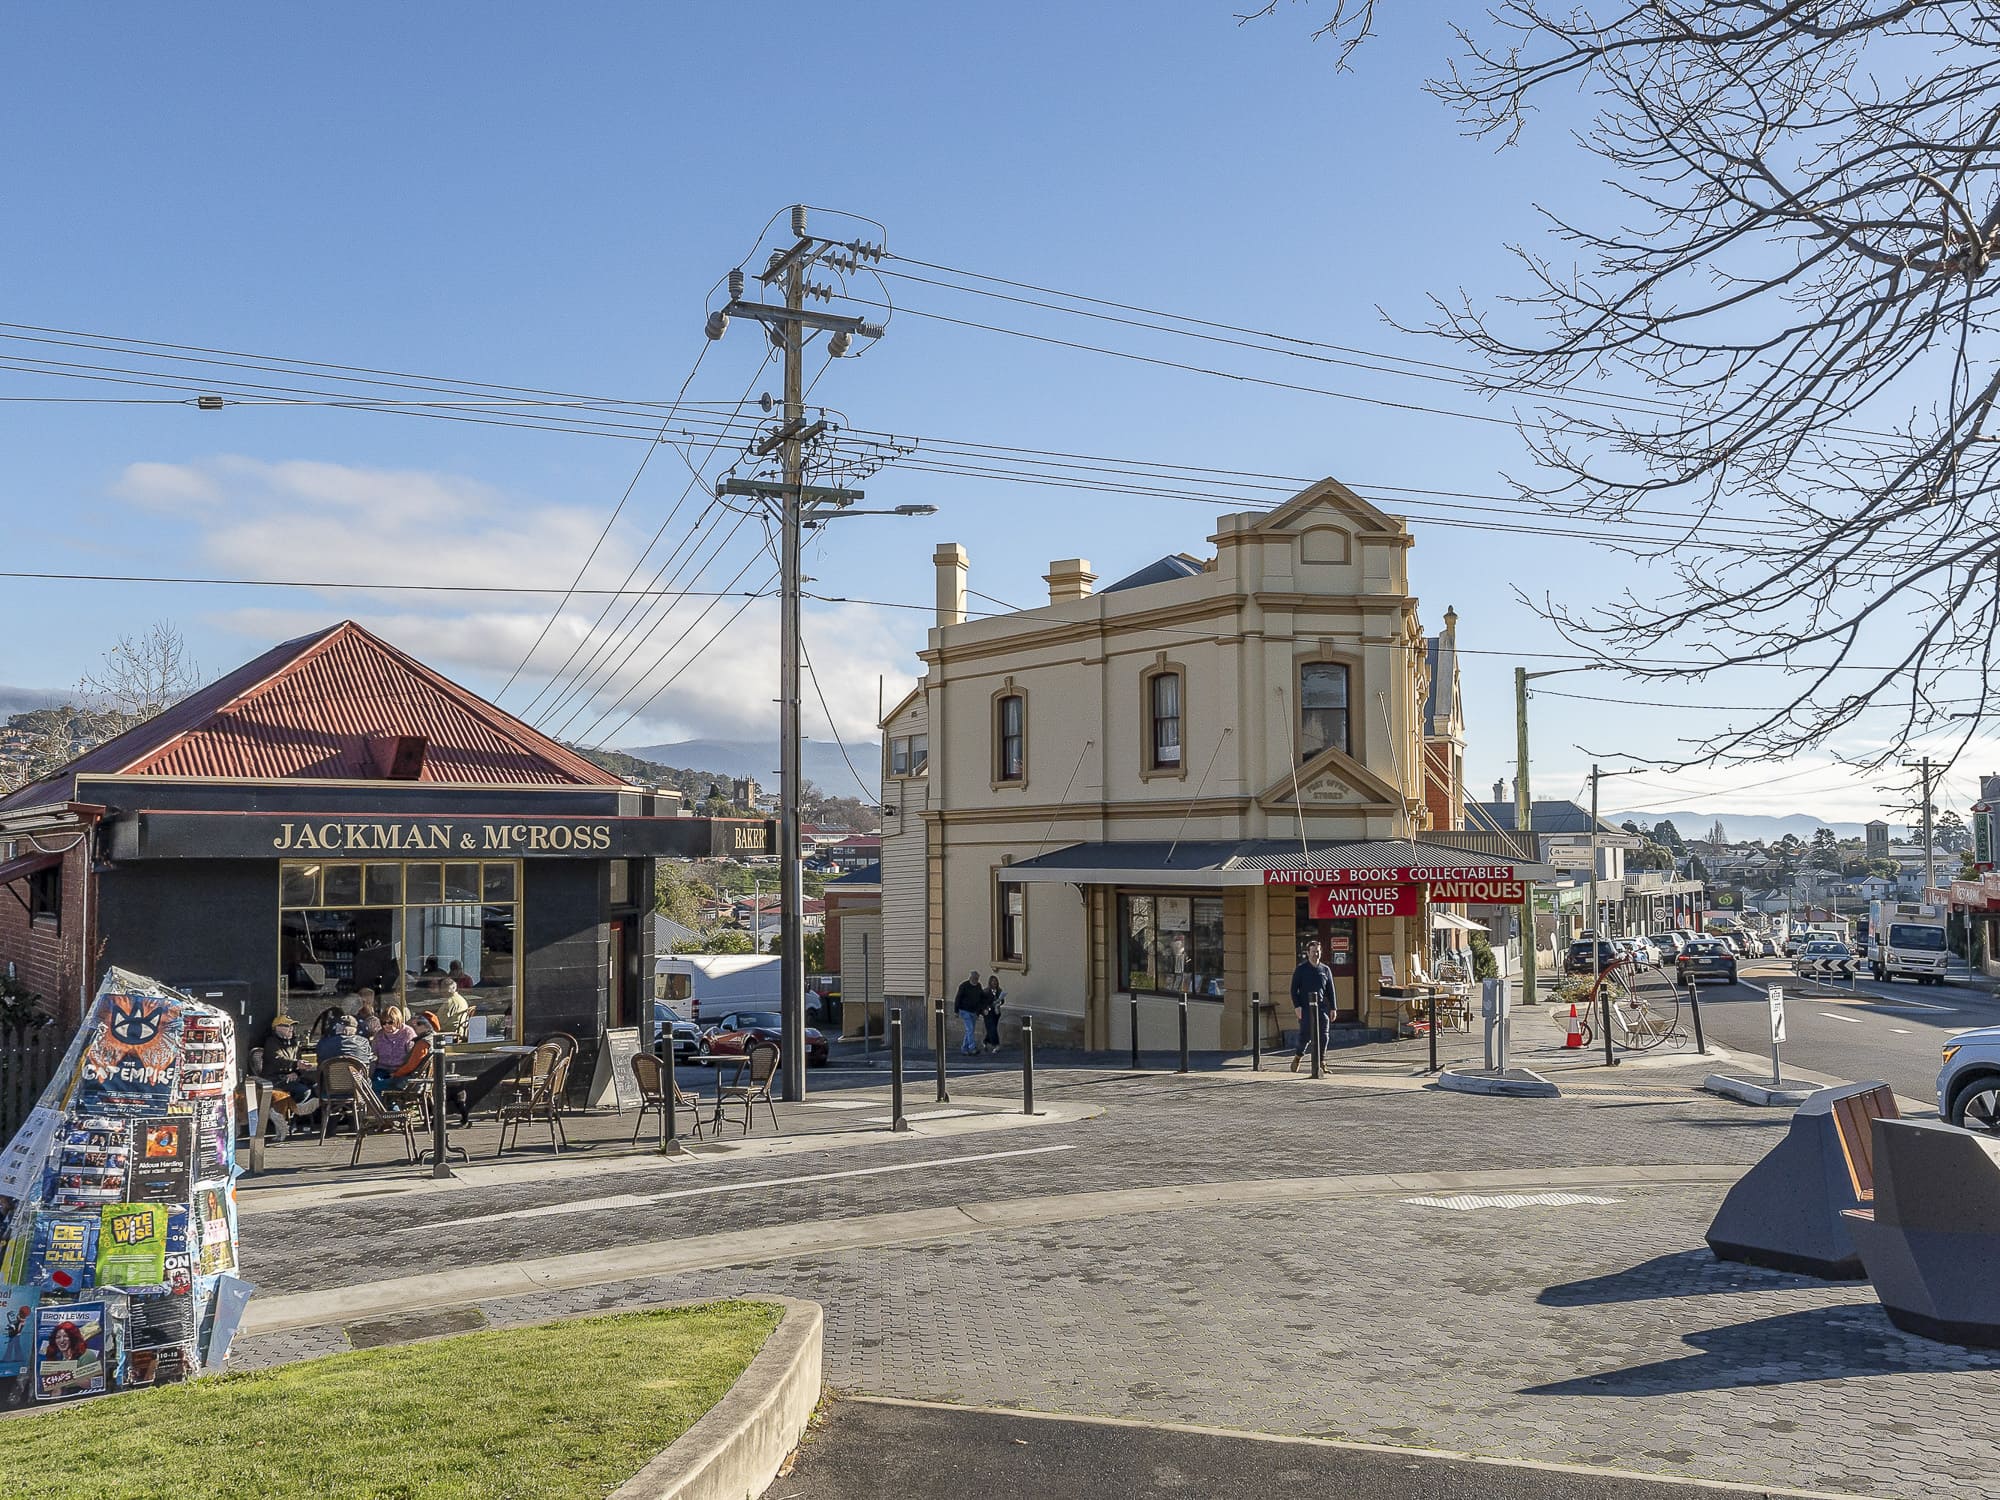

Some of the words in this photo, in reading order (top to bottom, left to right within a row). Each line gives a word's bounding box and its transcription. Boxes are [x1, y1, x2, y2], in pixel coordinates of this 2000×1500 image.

[273, 824, 452, 850] JACKMAN
[459, 832, 476, 850] &
[735, 827, 767, 849] BAKER
[1268, 869, 1341, 883] ANTIQUES
[1350, 868, 1398, 882] BOOKS
[1409, 866, 1509, 880] COLLECTABLES
[1327, 887, 1399, 902] ANTIQUES
[1432, 882, 1522, 900] ANTIQUES
[1332, 903, 1394, 916] WANTED
[82, 1064, 120, 1080] CAT
[121, 1066, 174, 1084] EMPIRE
[113, 1213, 153, 1231] BYTE
[53, 1225, 86, 1241] BE
[116, 1226, 153, 1243] WISE
[45, 1250, 85, 1261] CHILL
